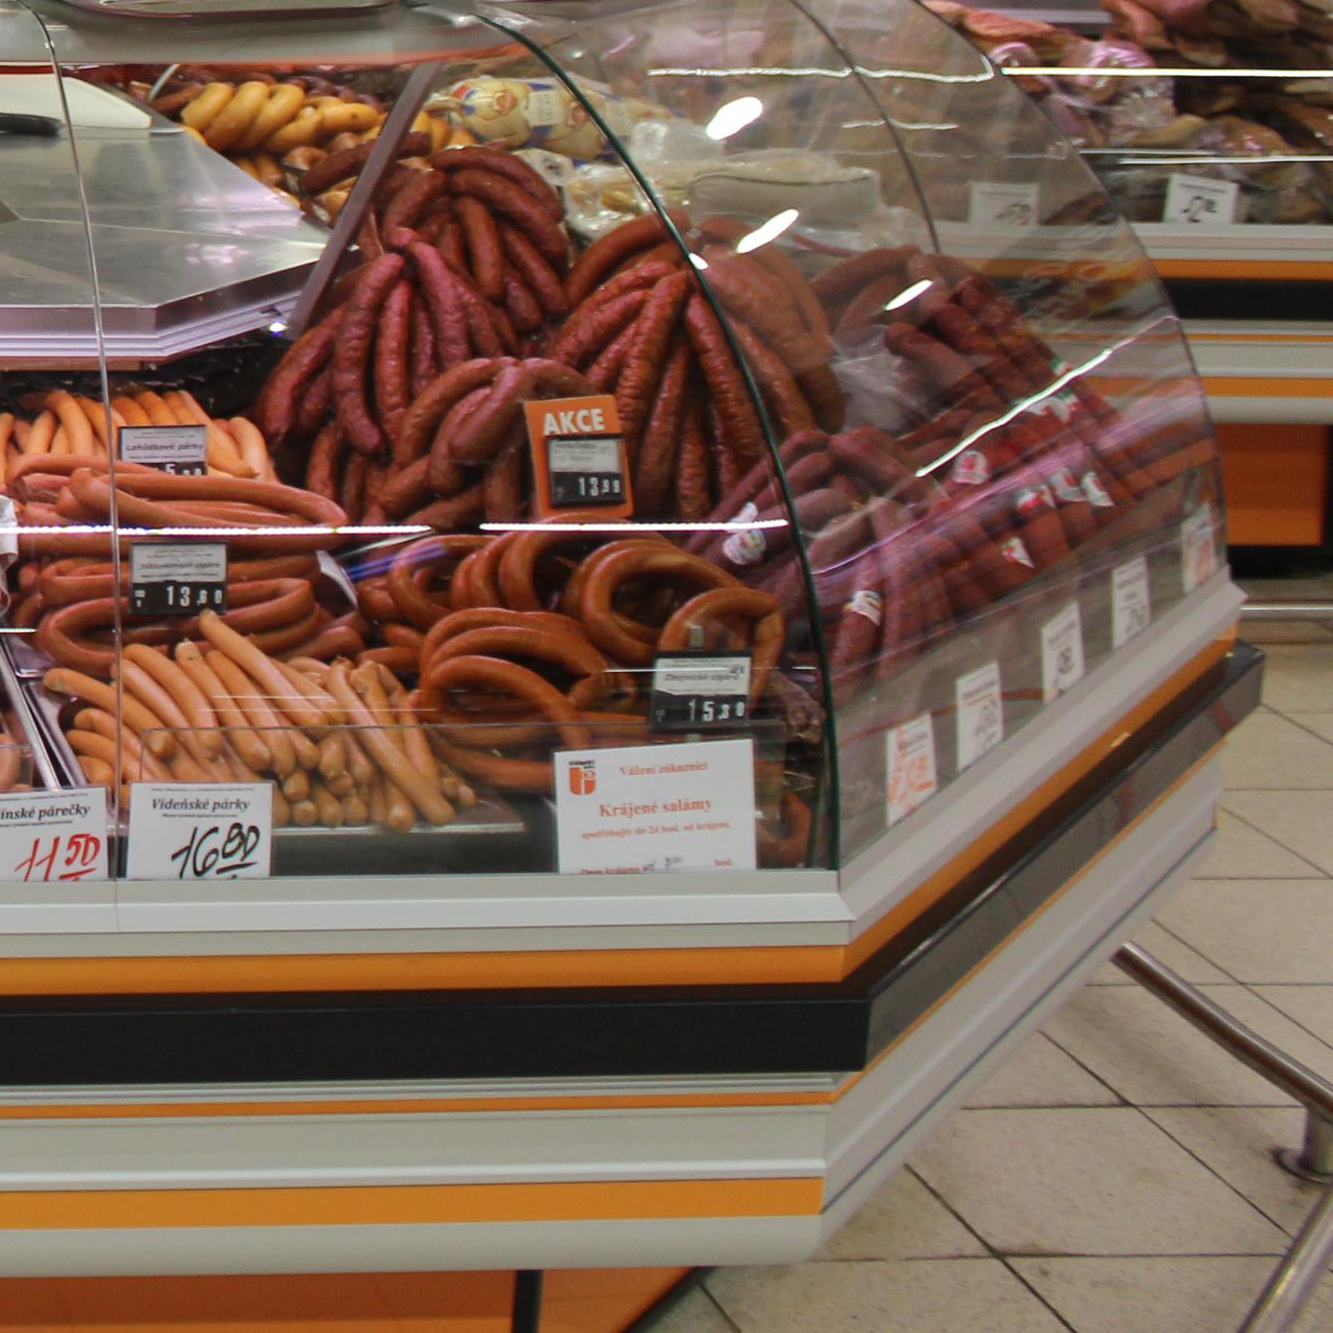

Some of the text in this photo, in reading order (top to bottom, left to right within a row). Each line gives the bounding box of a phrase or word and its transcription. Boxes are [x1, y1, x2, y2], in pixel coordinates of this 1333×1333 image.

[544, 409, 606, 436] AKCE
[37, 803, 91, 821] párečky
[213, 799, 251, 813] párky
[599, 799, 712, 818] Krájené salámy
